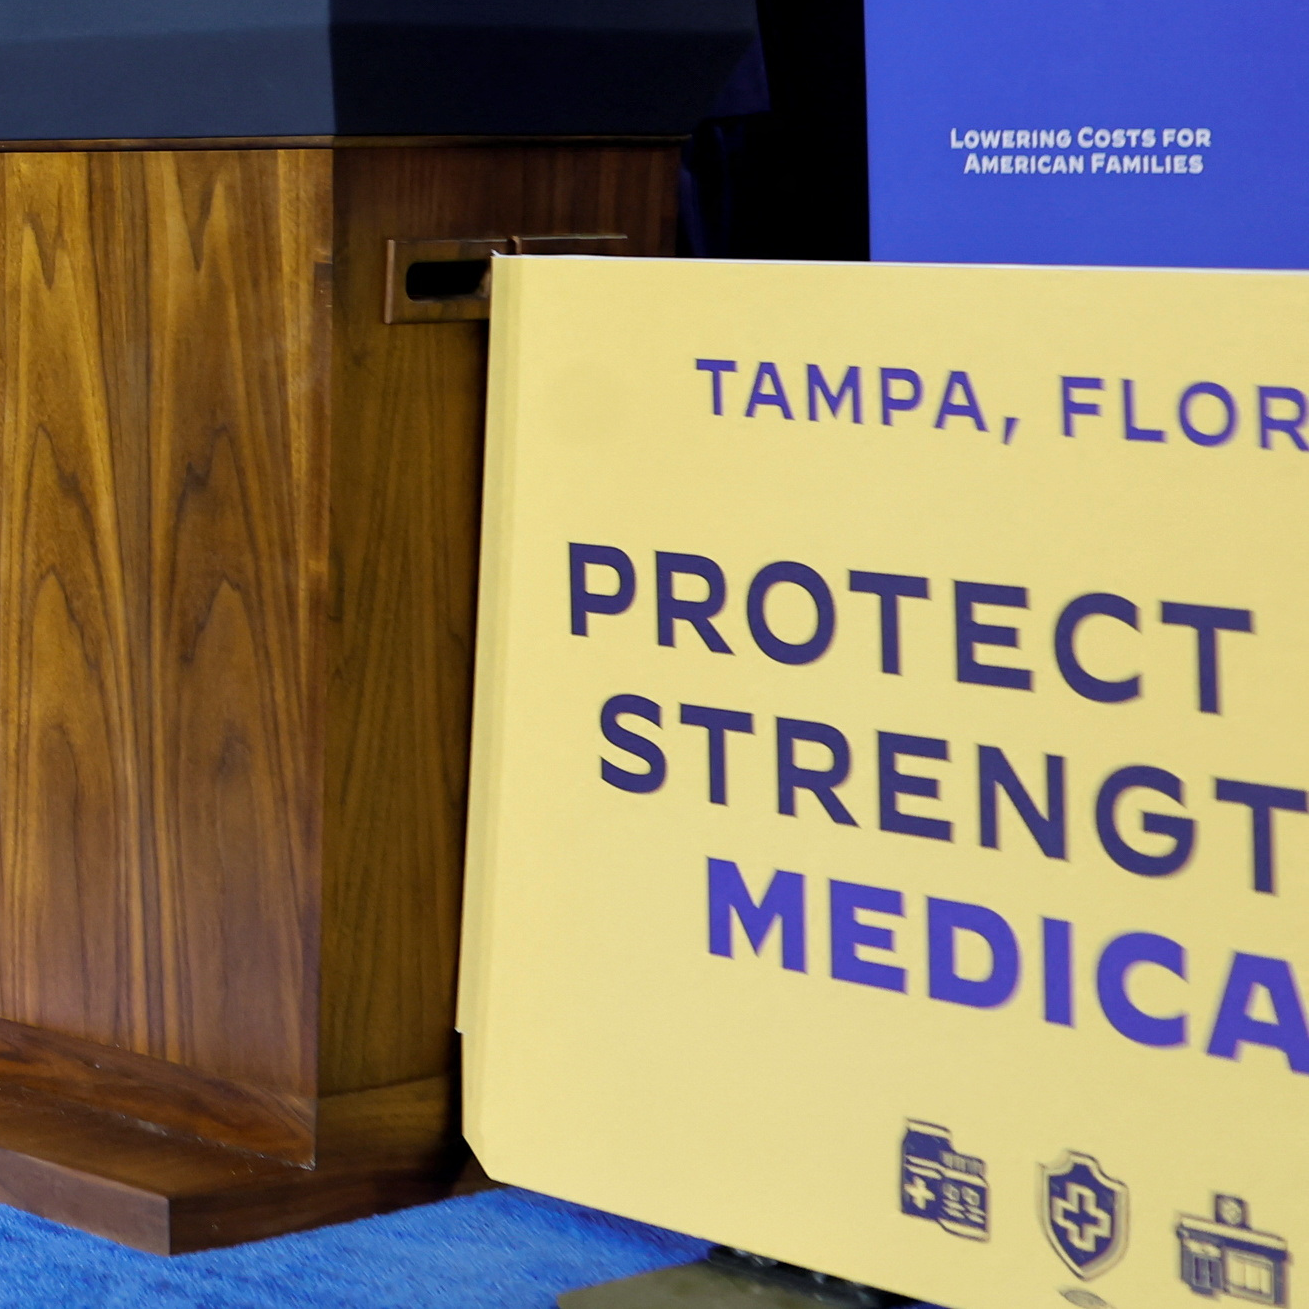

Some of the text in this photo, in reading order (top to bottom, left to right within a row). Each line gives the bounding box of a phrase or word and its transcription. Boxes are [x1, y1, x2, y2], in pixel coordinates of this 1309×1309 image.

[963, 152, 1204, 174] AMERICAN FAMILIES
[1162, 128, 1211, 148] FOR
[695, 358, 1309, 452] TAMPA, FLOR
[568, 541, 1254, 715] PROTECT
[598, 692, 1309, 897] STRENGT
[706, 855, 1309, 1077] MEDICA
